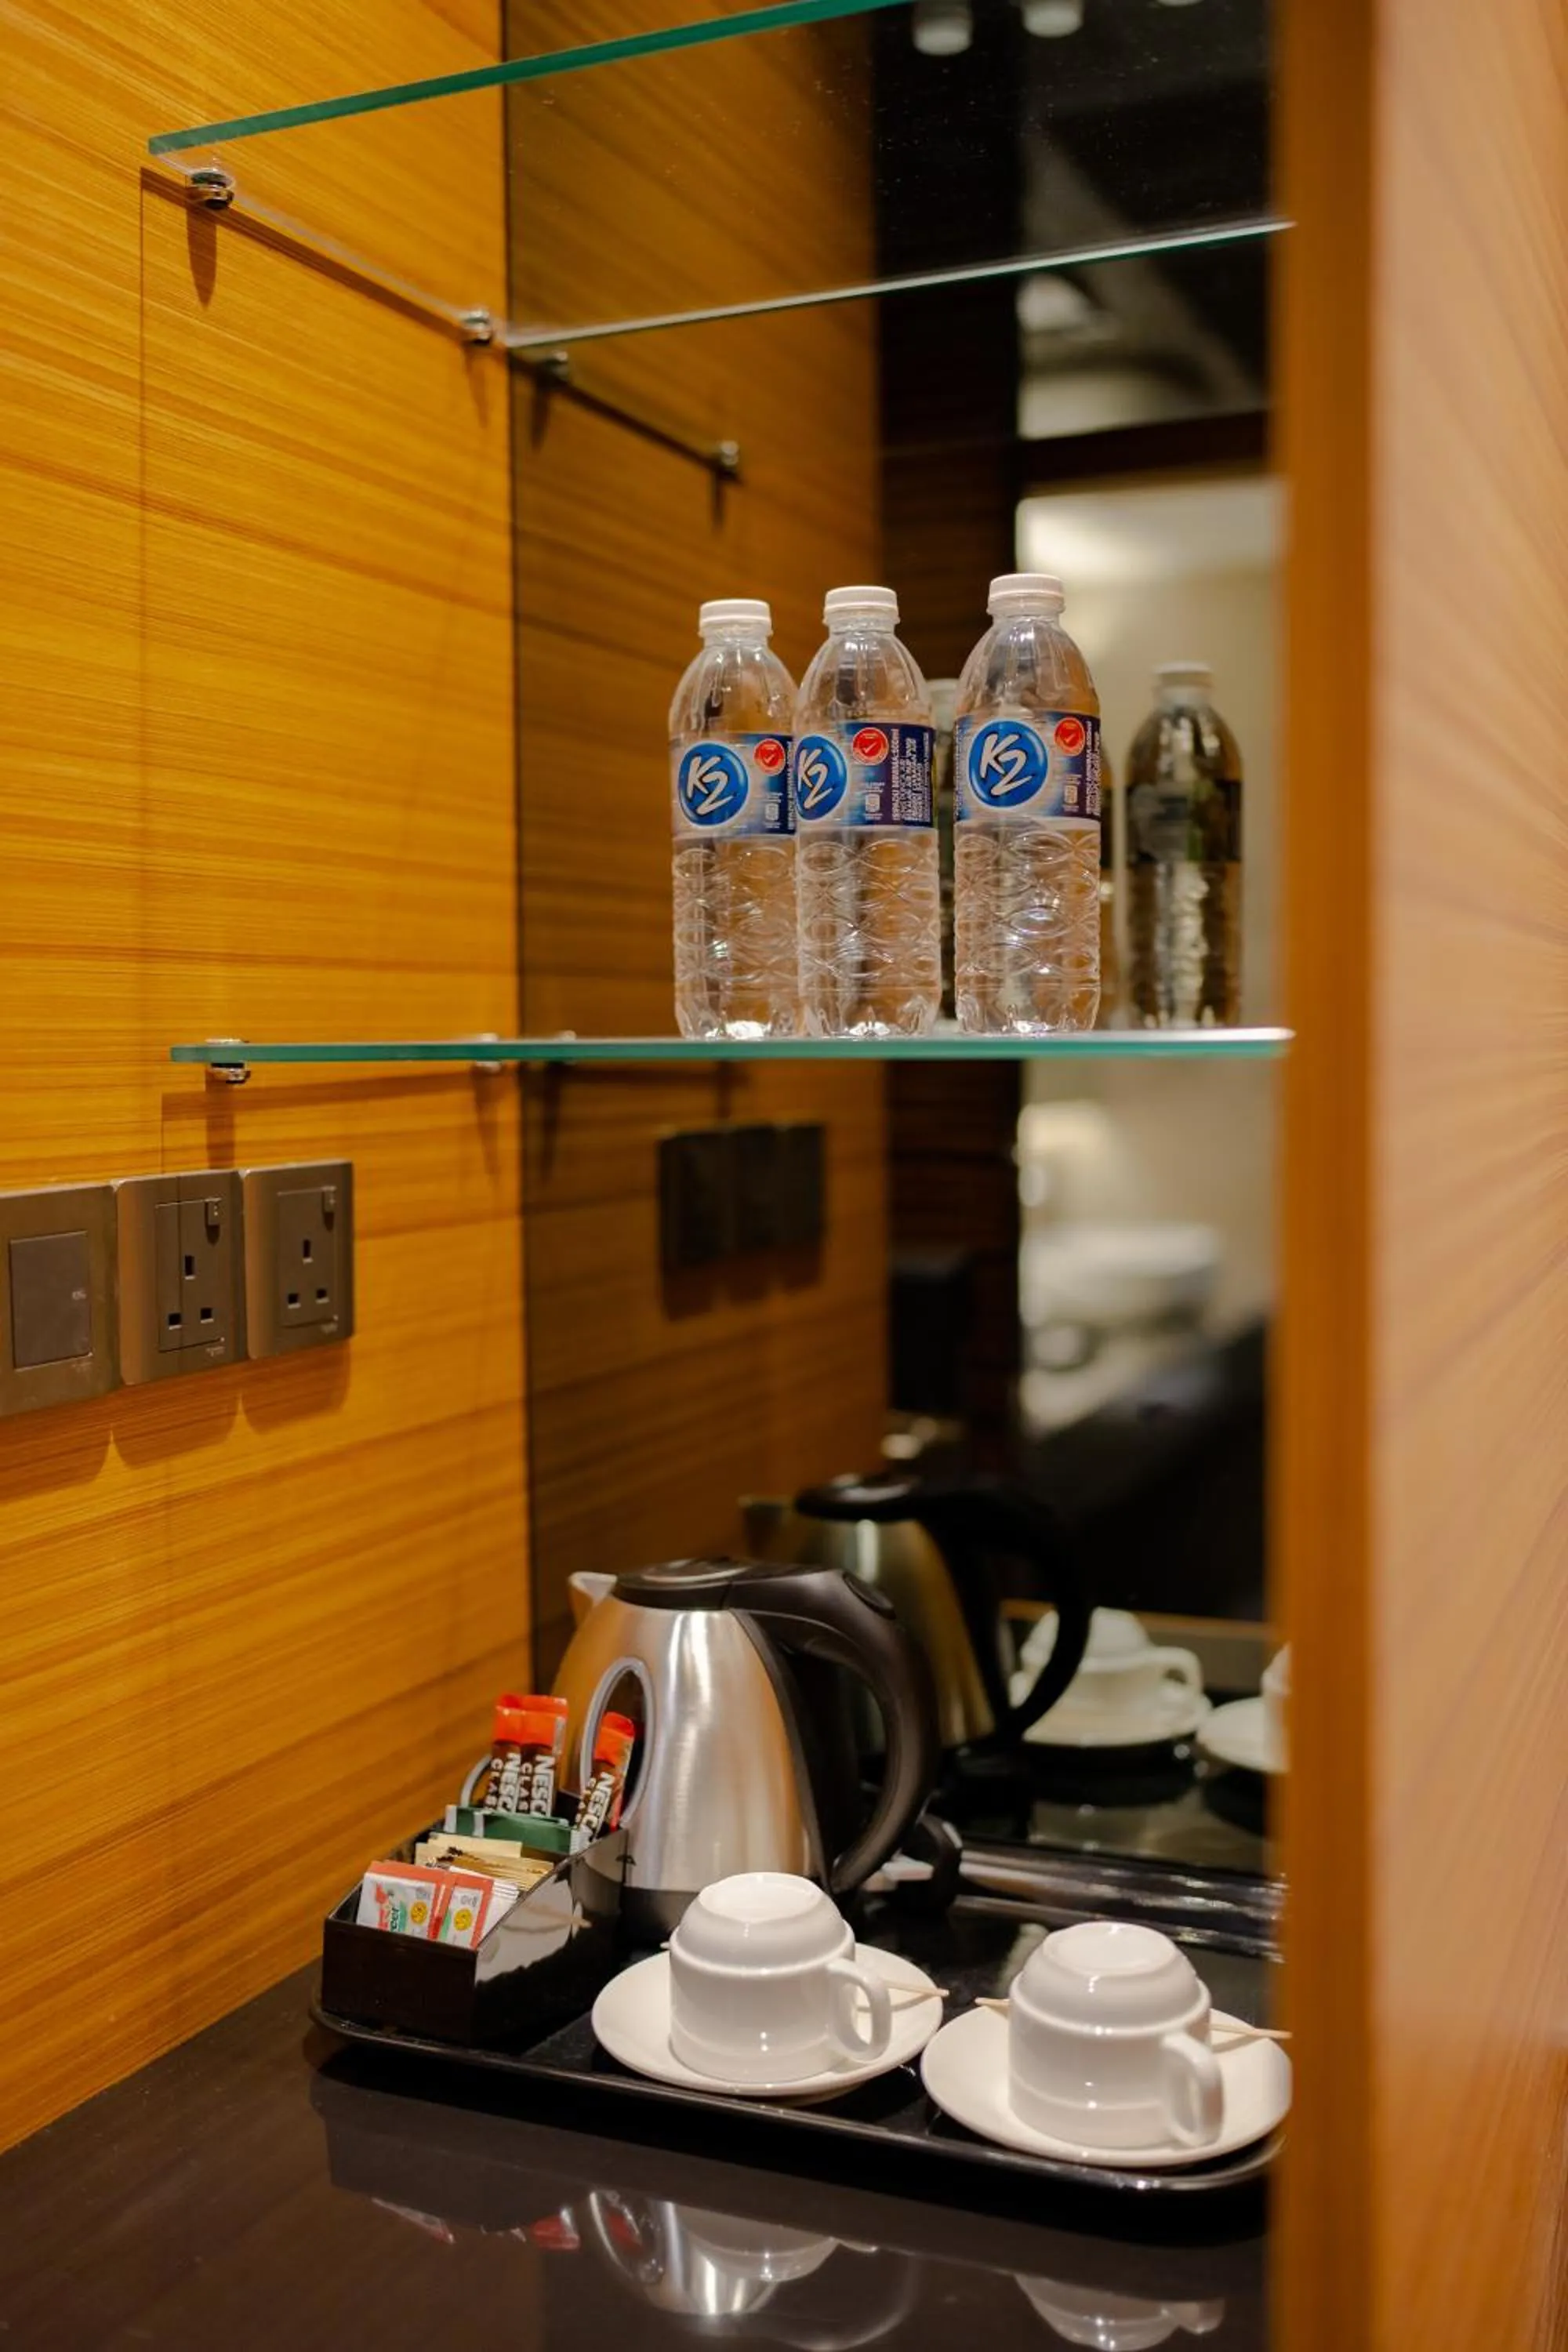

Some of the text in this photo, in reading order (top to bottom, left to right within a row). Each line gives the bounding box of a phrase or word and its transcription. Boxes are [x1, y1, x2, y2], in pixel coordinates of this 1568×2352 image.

[686, 755, 735, 815] K2
[797, 748, 833, 809] K2
[981, 733, 1033, 796] K2
[485, 1758, 504, 1808] CLAS
[496, 1752, 521, 1813] NESC
[530, 1754, 556, 1817] NESC
[582, 1772, 615, 1830] NESC
